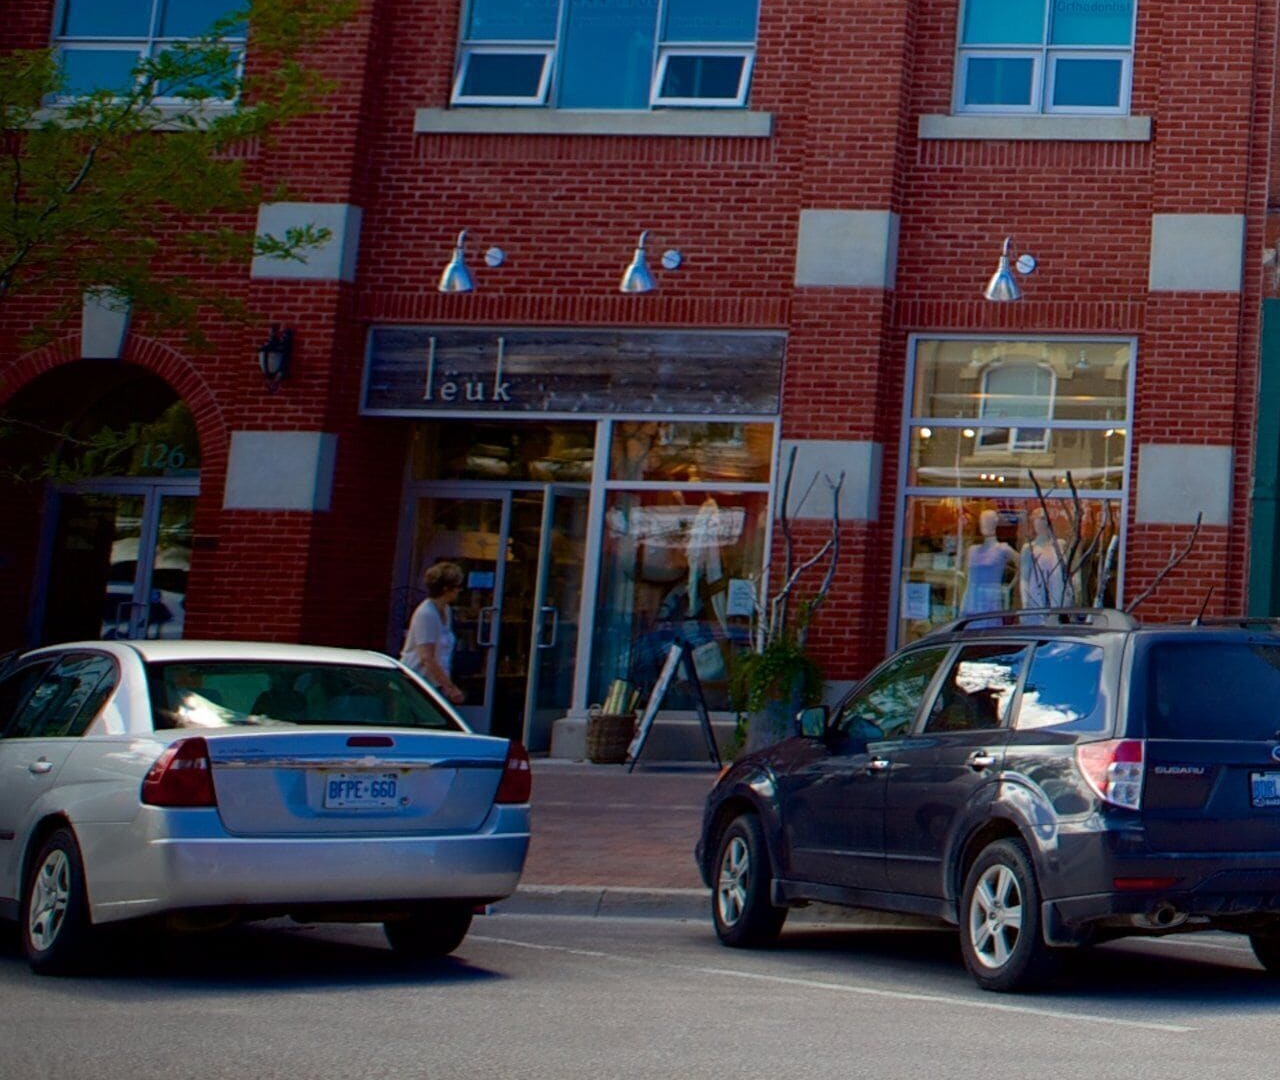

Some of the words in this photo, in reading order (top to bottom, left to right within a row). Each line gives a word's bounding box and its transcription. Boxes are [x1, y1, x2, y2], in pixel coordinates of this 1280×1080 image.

[1057, 1, 1131, 13] Orthodontist
[143, 443, 186, 468] 126
[1154, 766, 1205, 774] SUBARU
